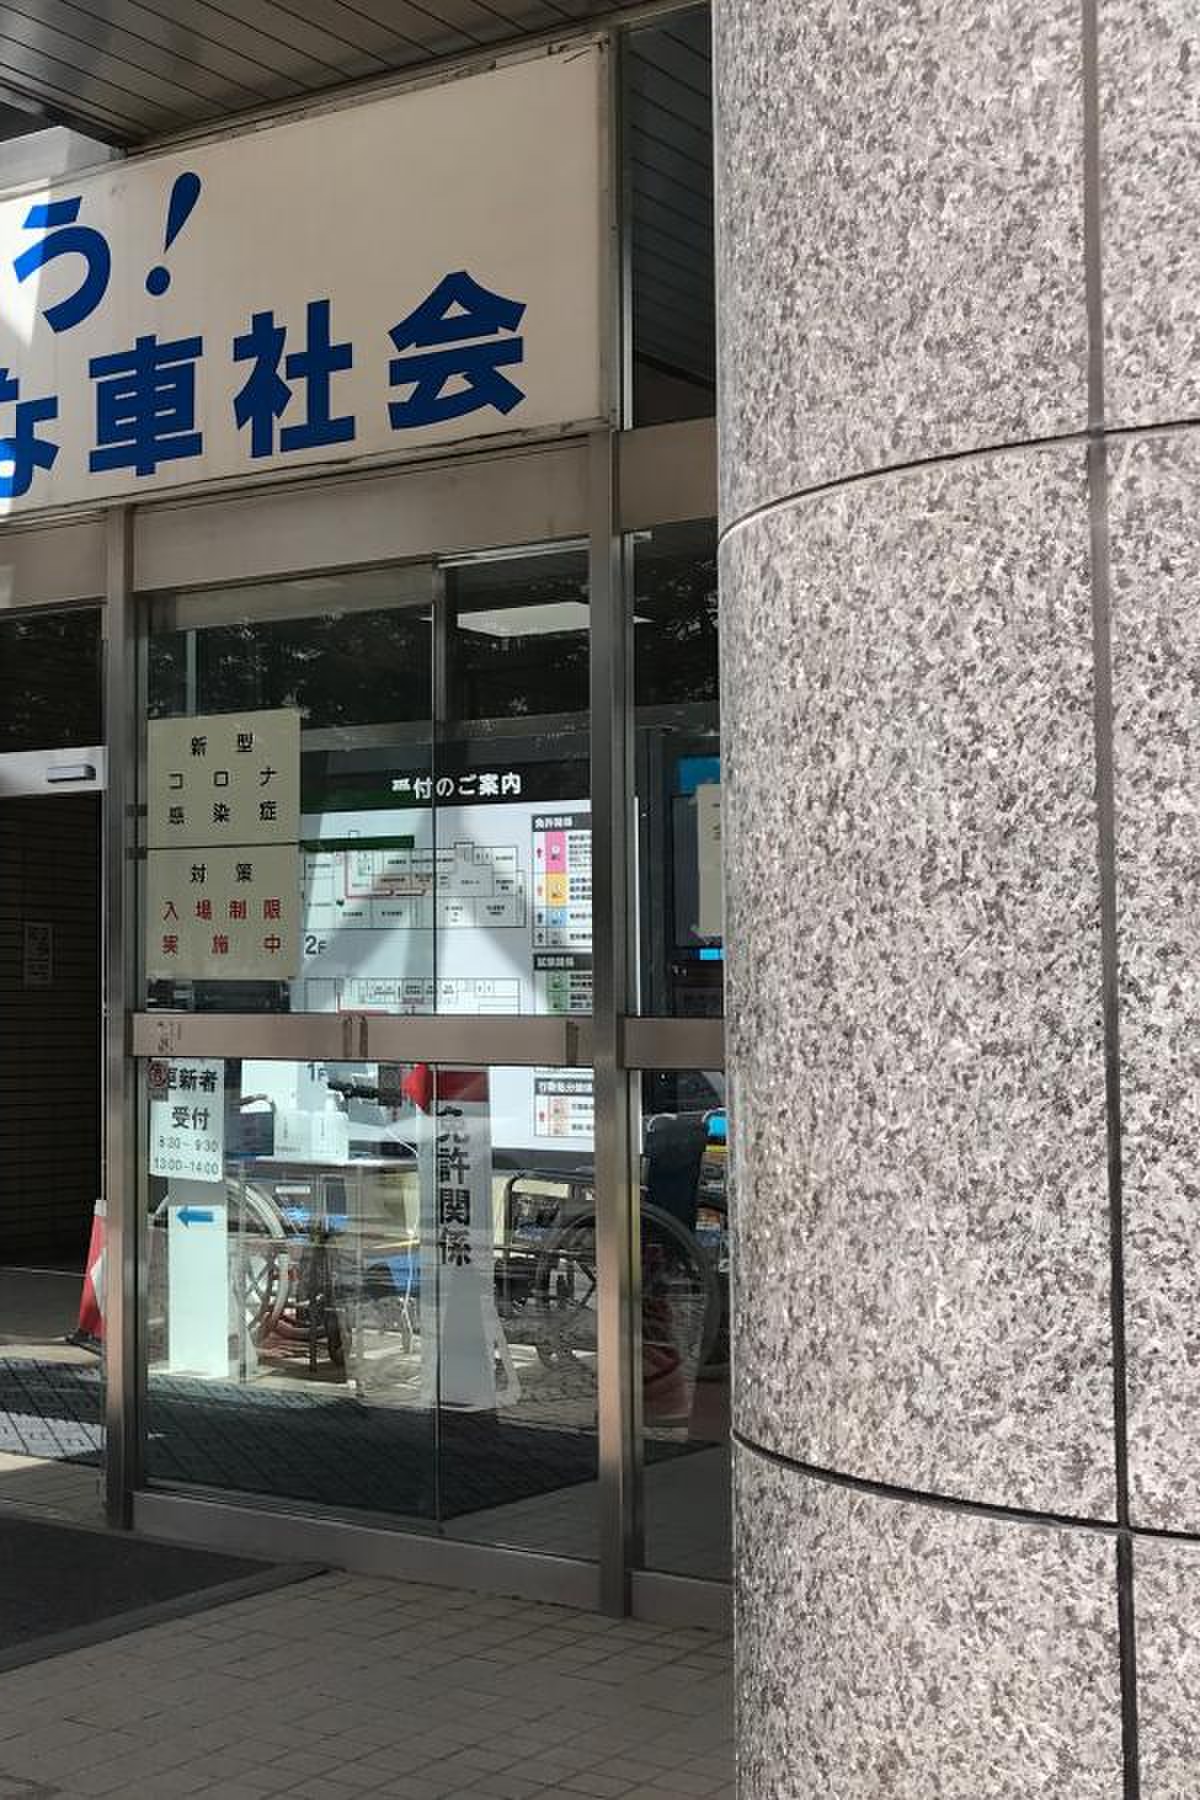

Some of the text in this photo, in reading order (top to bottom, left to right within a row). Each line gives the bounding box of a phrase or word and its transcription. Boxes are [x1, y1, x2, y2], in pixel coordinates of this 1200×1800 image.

[191, 731, 254, 757] 新型
[168, 767, 278, 790] コロナ
[168, 801, 278, 825] 感染症
[190, 863, 254, 883] 対策
[163, 900, 281, 921] 入場制限
[162, 934, 281, 955] 実施中
[305, 935, 327, 955] 2F
[171, 1106, 211, 1131] 受付
